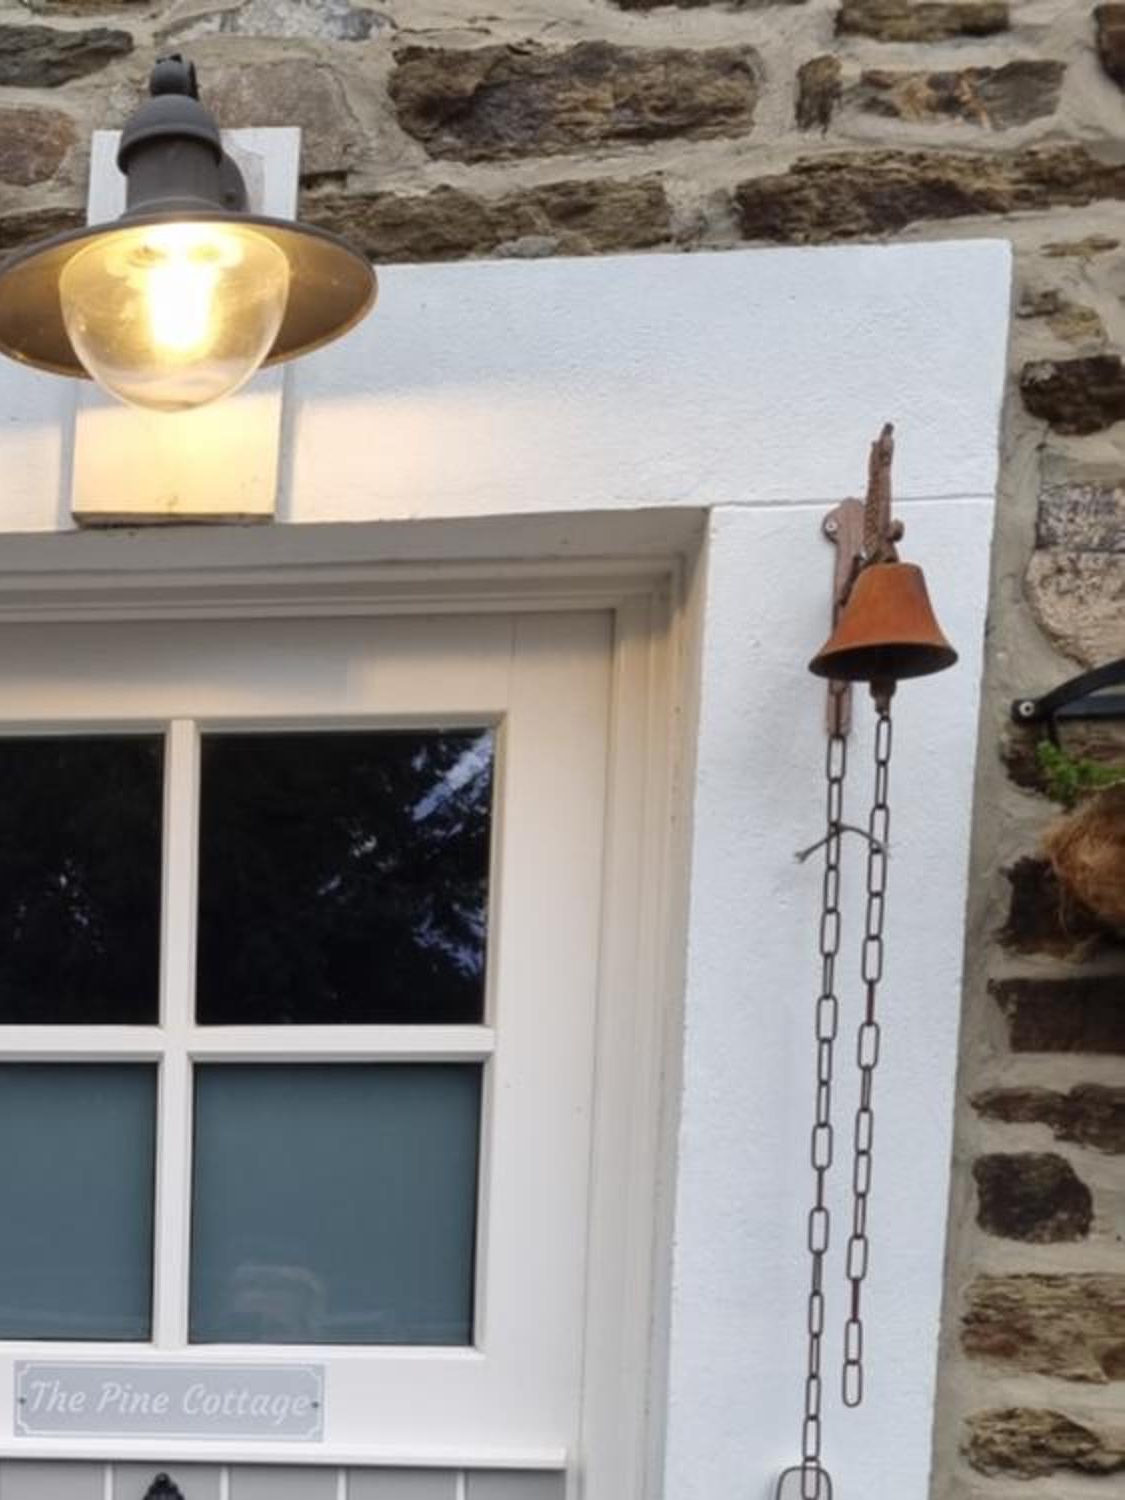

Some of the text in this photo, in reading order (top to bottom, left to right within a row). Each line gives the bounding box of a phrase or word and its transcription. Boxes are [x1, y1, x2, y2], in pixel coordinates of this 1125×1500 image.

[29, 1379, 309, 1425] The Pine Cottage
